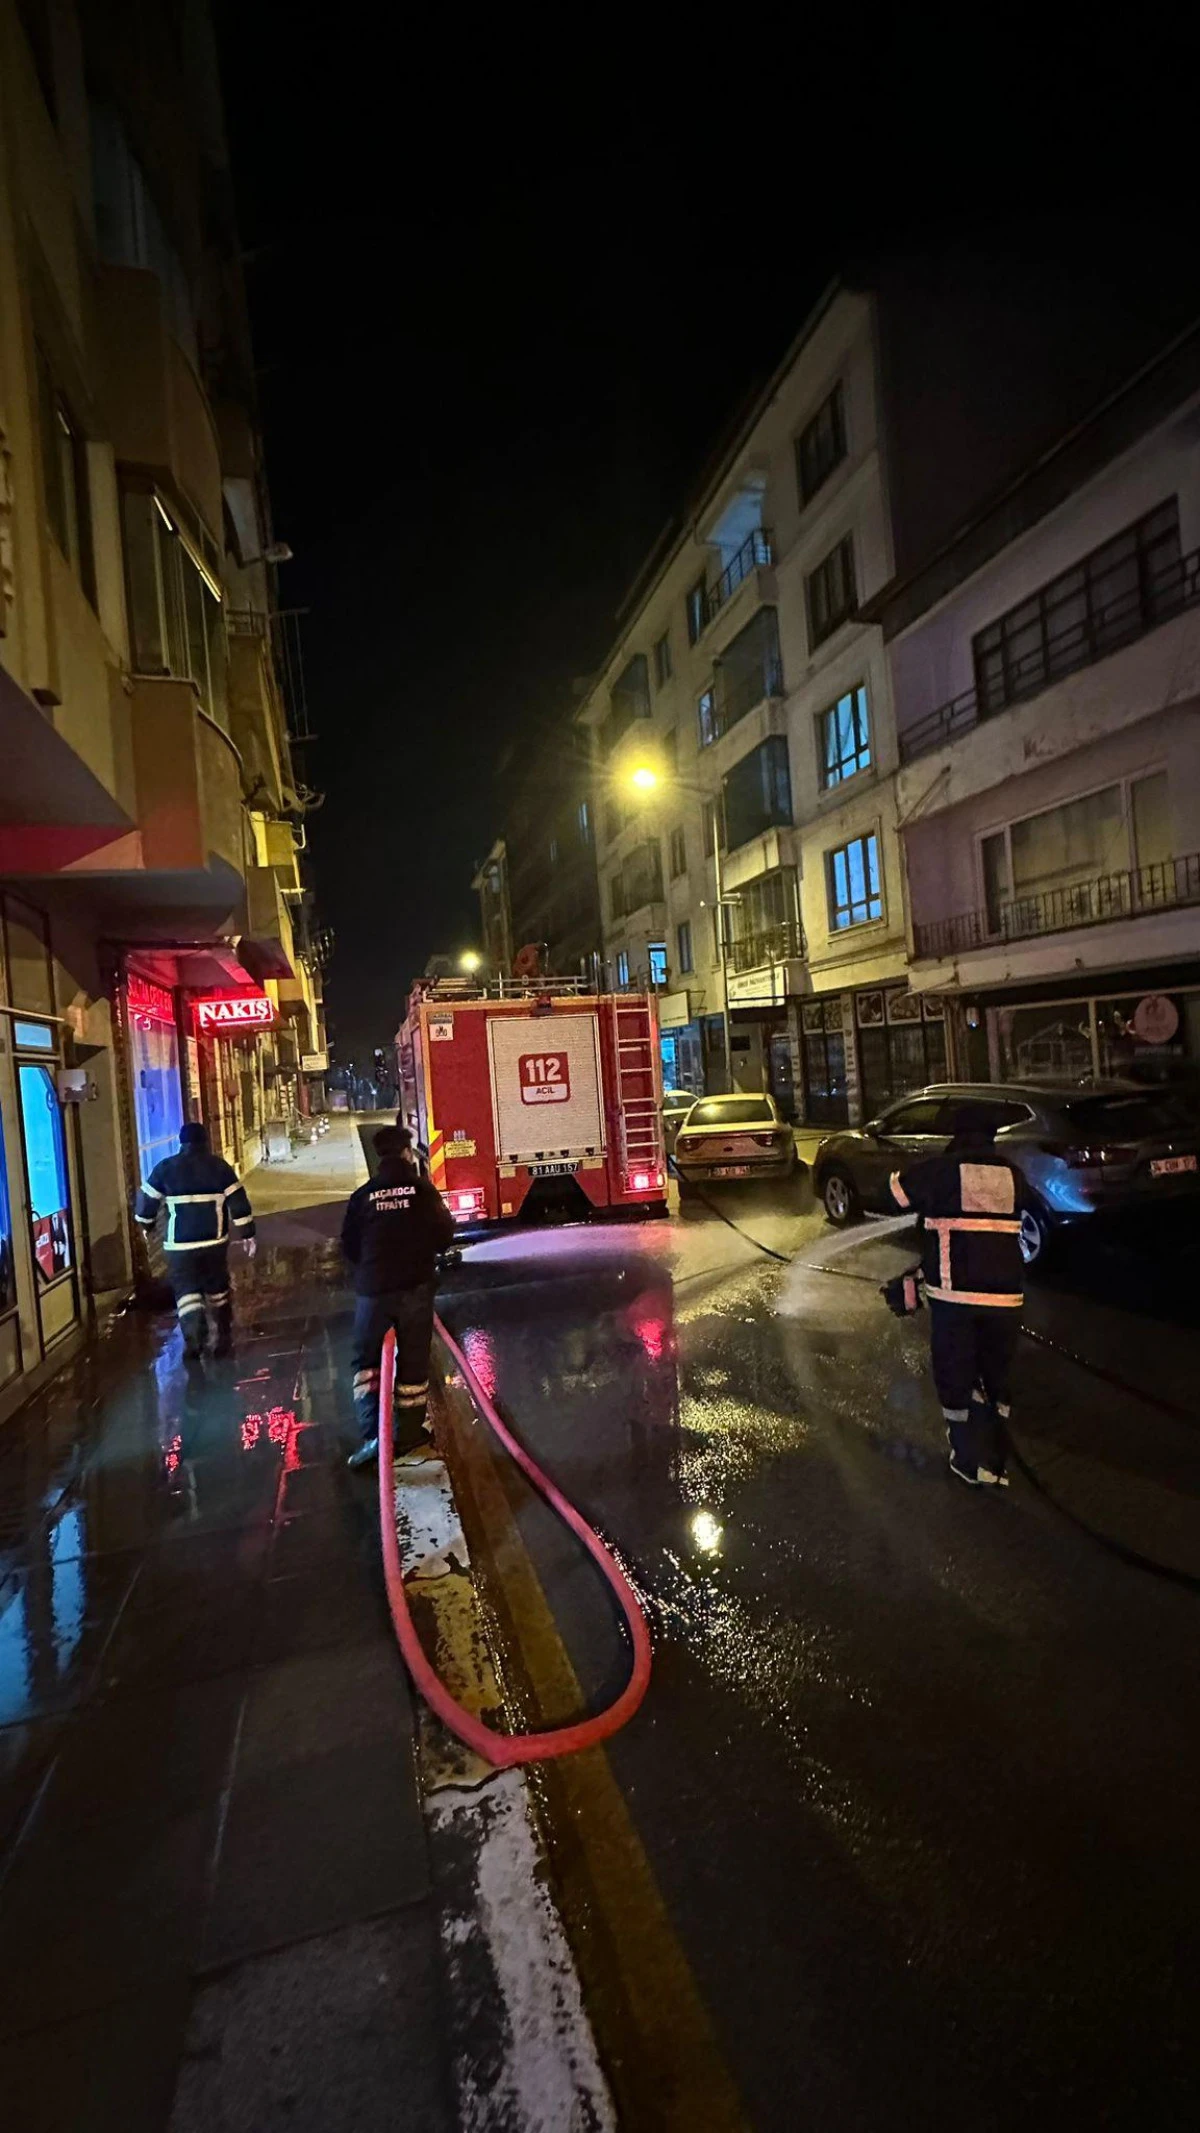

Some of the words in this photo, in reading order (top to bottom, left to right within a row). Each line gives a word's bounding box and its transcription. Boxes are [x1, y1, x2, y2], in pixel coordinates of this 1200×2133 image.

[200, 1001, 268, 1021] NAKIŞ
[525, 1057, 562, 1083] 112
[532, 1166, 543, 1175] 81
[545, 1164, 561, 1174] AAU
[368, 1186, 416, 1201] AKÇAKOCA
[376, 1198, 410, 1212] İTFAİYE
